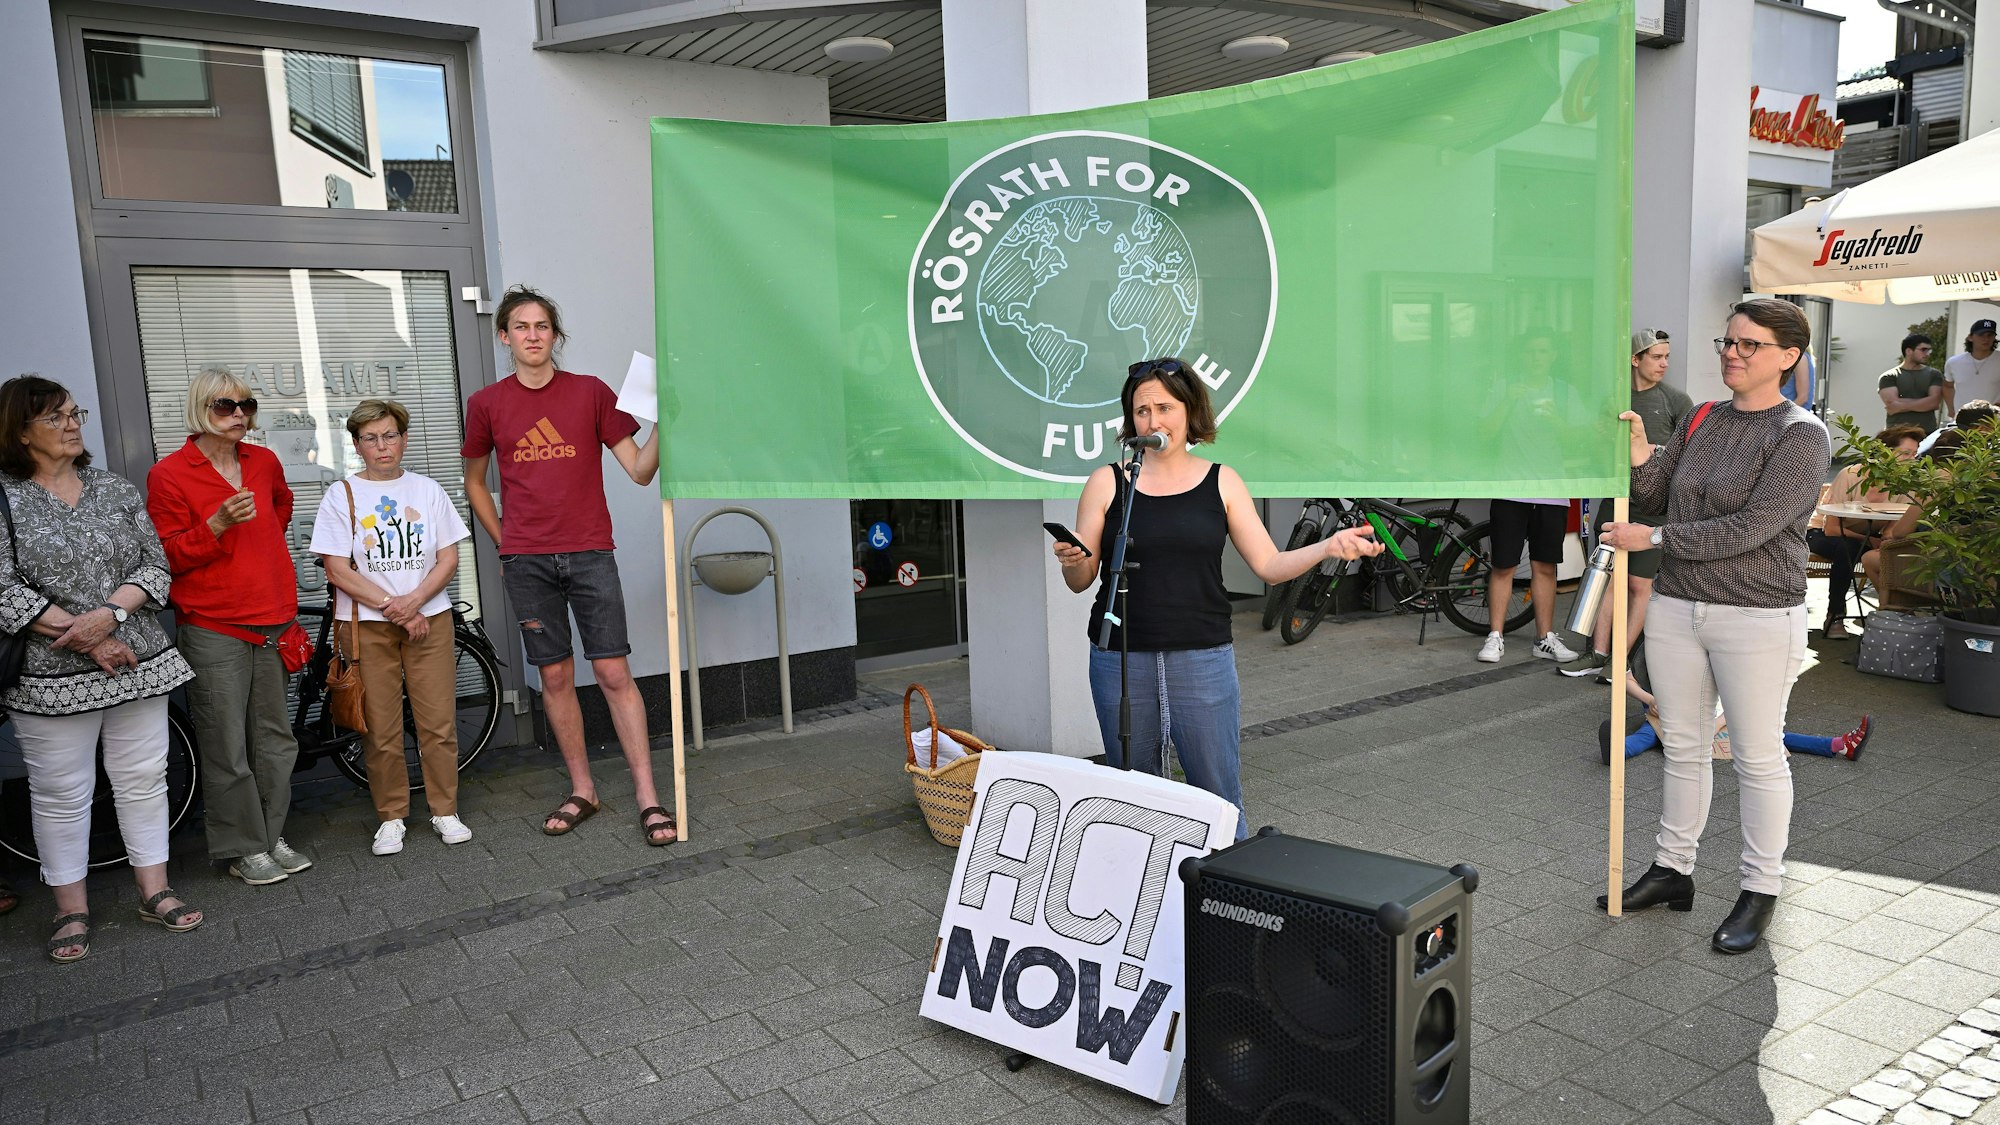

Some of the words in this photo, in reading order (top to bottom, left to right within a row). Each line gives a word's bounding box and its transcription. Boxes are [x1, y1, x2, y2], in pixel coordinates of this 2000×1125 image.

[1750, 85, 1791, 143] ona
[1790, 94, 1845, 151] Lisa
[923, 158, 1071, 323] RÖSRATH
[1086, 156, 1190, 207] FOR
[1813, 225, 1923, 267] Segafredo
[1849, 262, 1889, 271] ZANETTI
[201, 361, 405, 397] AUAMT
[1041, 353, 1231, 460] FUE
[513, 443, 577, 463] adidas
[367, 561, 401, 572] BLESSED
[404, 559, 425, 571] MESS
[1200, 898, 1285, 932] SOUNDBOKS
[937, 925, 1173, 1066] NOW
